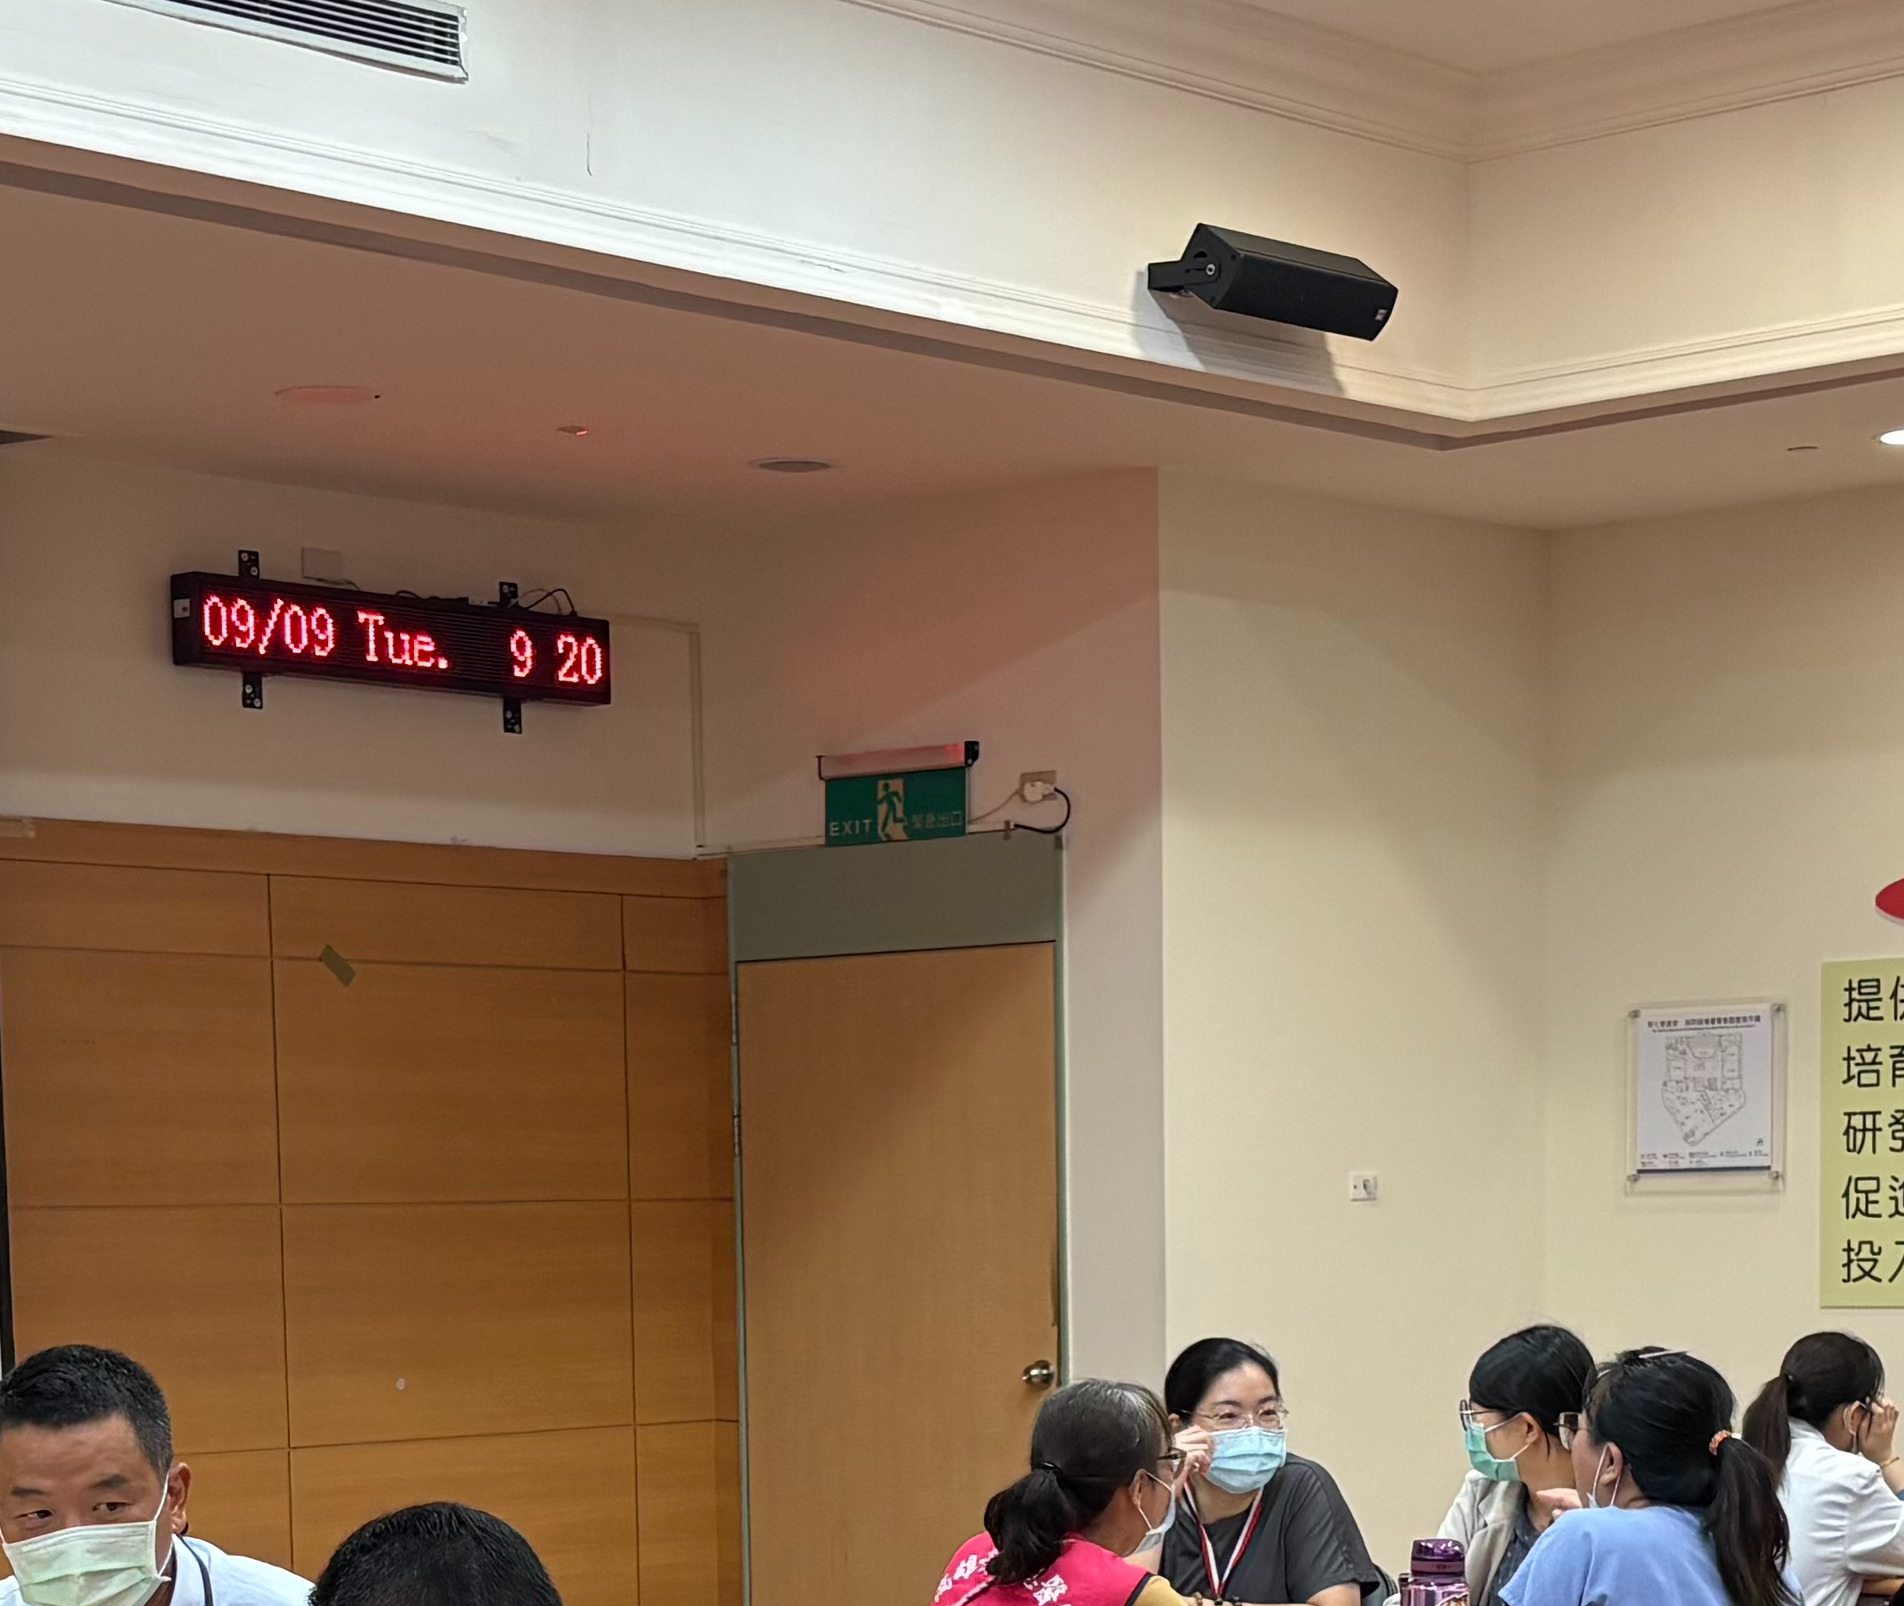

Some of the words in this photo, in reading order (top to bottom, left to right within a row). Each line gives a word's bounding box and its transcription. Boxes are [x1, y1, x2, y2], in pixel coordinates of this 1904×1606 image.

[202, 594, 336, 657] 09/09
[357, 610, 450, 669] Tue.
[509, 628, 534, 678] 9
[556, 632, 603, 684] 20
[829, 819, 873, 836] EXIT
